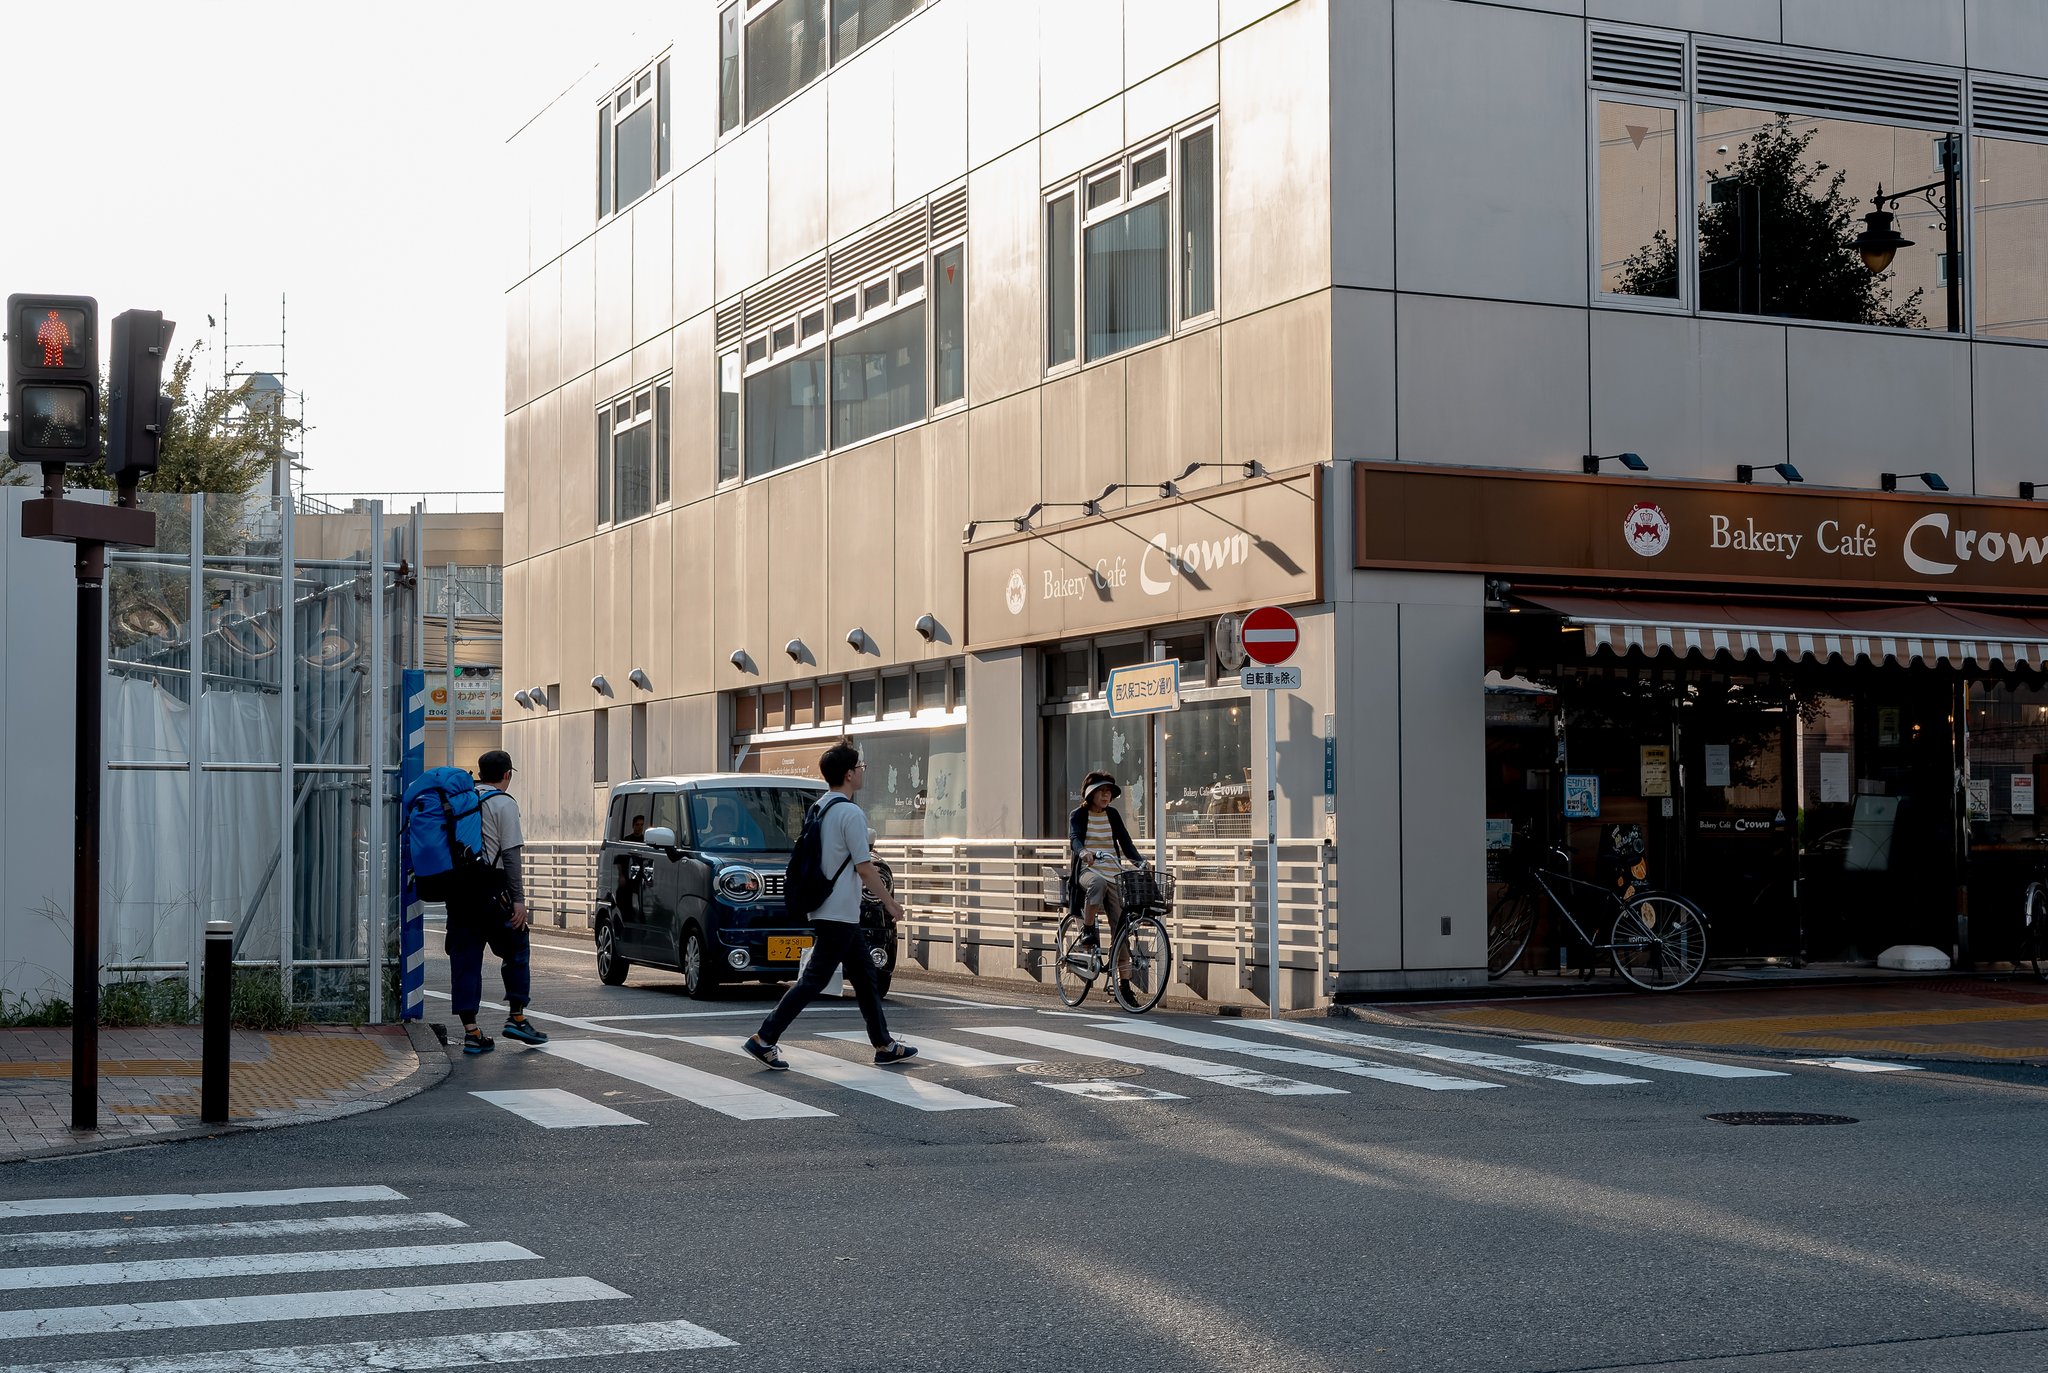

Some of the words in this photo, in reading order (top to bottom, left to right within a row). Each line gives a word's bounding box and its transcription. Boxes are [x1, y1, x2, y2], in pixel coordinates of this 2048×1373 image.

[1710, 514, 1802, 560] Bakery
[1816, 519, 1877, 557] Café
[1043, 569, 1087, 601] Bakery
[1095, 556, 1127, 590] Café
[1140, 532, 1249, 596] Crown
[1115, 677, 1172, 701] 西久保コミセン通り
[1246, 672, 1296, 685] 自転車を除く
[1213, 782, 1243, 800] Crown
[1699, 820, 1717, 830] Bakery
[1719, 820, 1731, 829] Café
[1735, 818, 1770, 831] Crown
